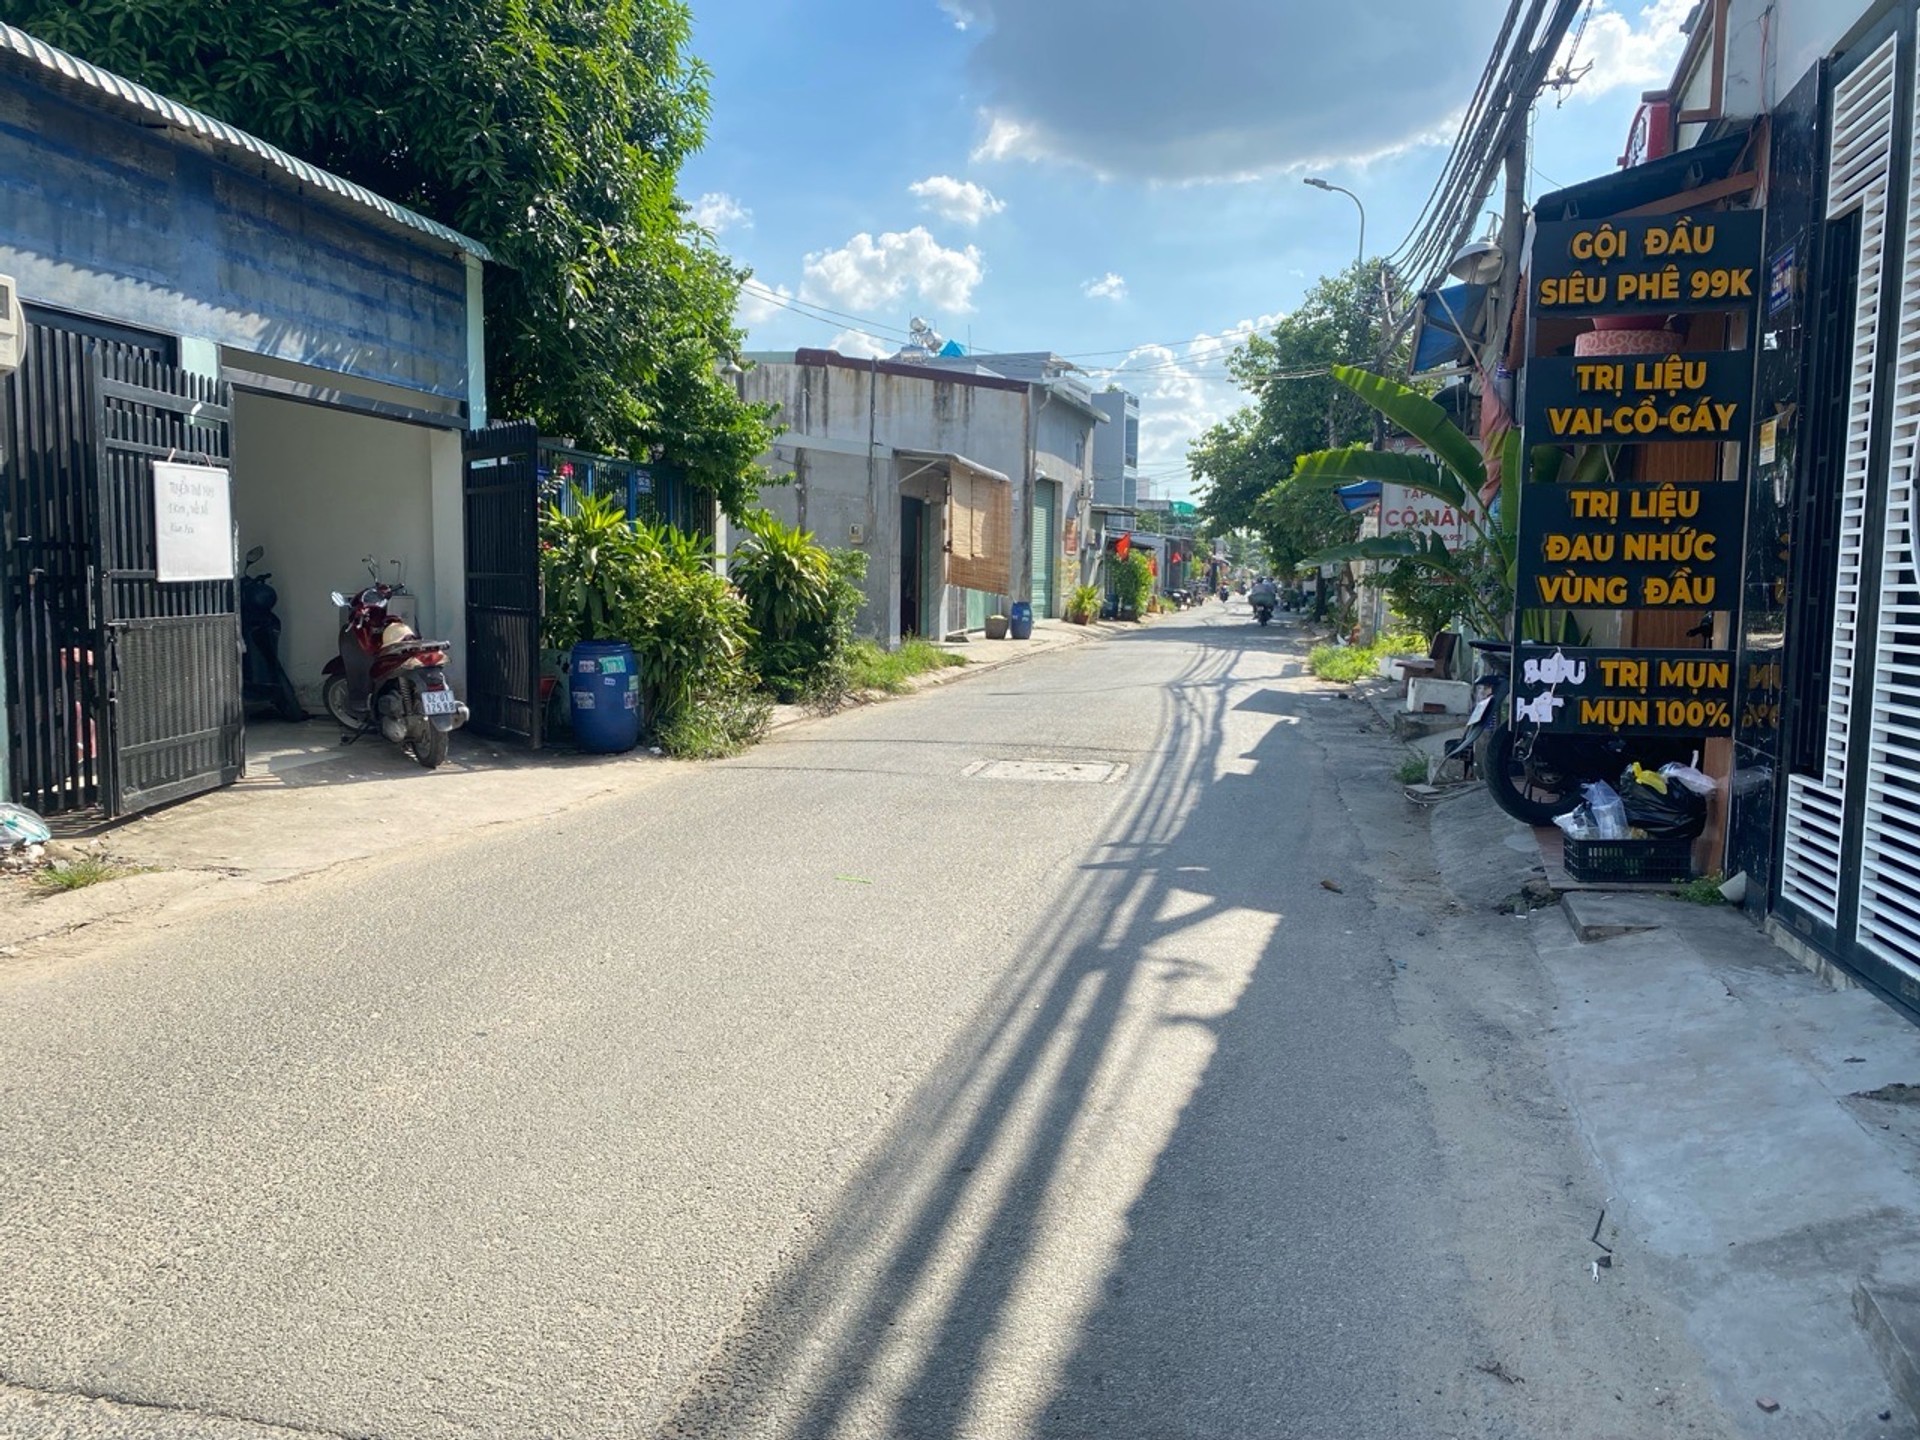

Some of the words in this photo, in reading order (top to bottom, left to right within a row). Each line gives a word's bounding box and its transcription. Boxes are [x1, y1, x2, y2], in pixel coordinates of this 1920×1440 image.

[1572, 223, 1627, 266] GỘI
[1644, 216, 1715, 255] ĐẦU
[1540, 270, 1606, 305] SIÊU
[1617, 264, 1680, 300] PHÊ
[1691, 269, 1753, 298] 99K
[1576, 364, 1623, 396] TRỊ
[1635, 354, 1707, 396] LIỆU
[1550, 395, 1737, 435] VAI-CỔ-GÁY
[1570, 490, 1619, 524] TRỊ
[1630, 483, 1700, 524] LIỆU
[1546, 535, 1615, 561] ĐAU
[1624, 526, 1716, 560] NHỨC
[1538, 569, 1628, 603] VÙNG
[1644, 567, 1716, 603] ĐẦU
[1600, 660, 1648, 694] TRỊ
[1660, 660, 1729, 694] MỤN
[1581, 699, 1648, 731] MỤN
[1657, 700, 1730, 726] 100%
